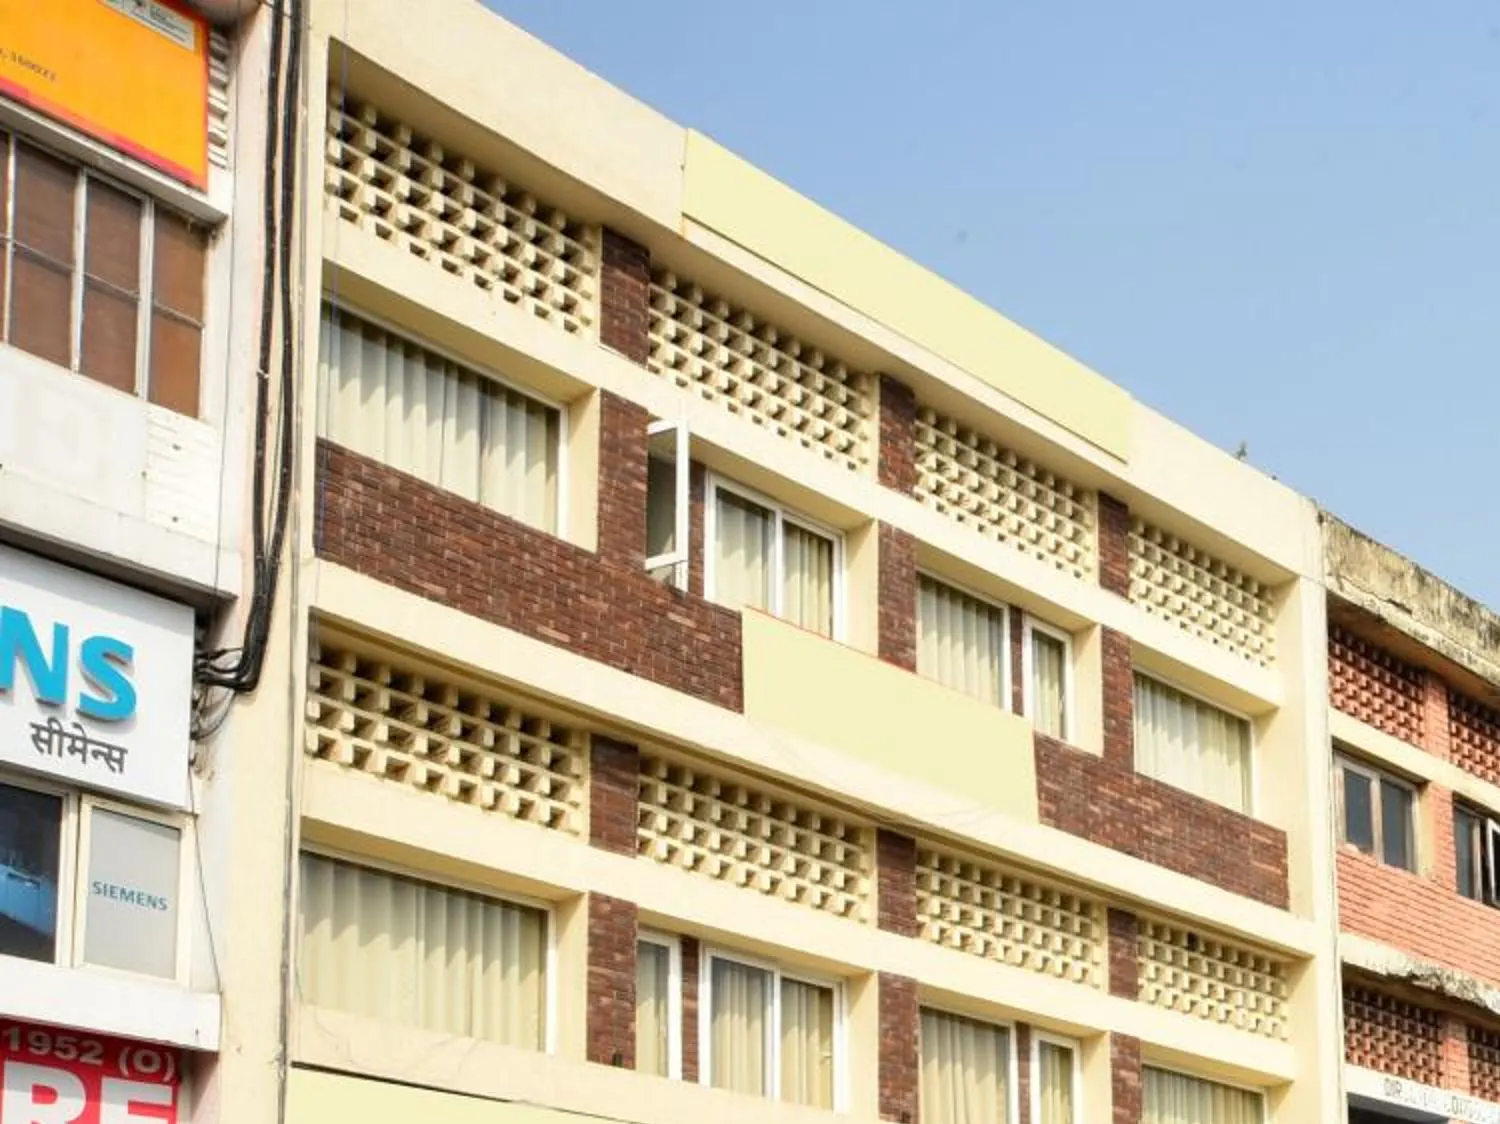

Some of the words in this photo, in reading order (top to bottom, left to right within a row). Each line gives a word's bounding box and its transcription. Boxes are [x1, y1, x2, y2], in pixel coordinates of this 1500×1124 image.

[29, 716, 128, 774] सीमेन्स
[92, 880, 168, 911] SIEMENS
[2, 1026, 104, 1066] 1952
